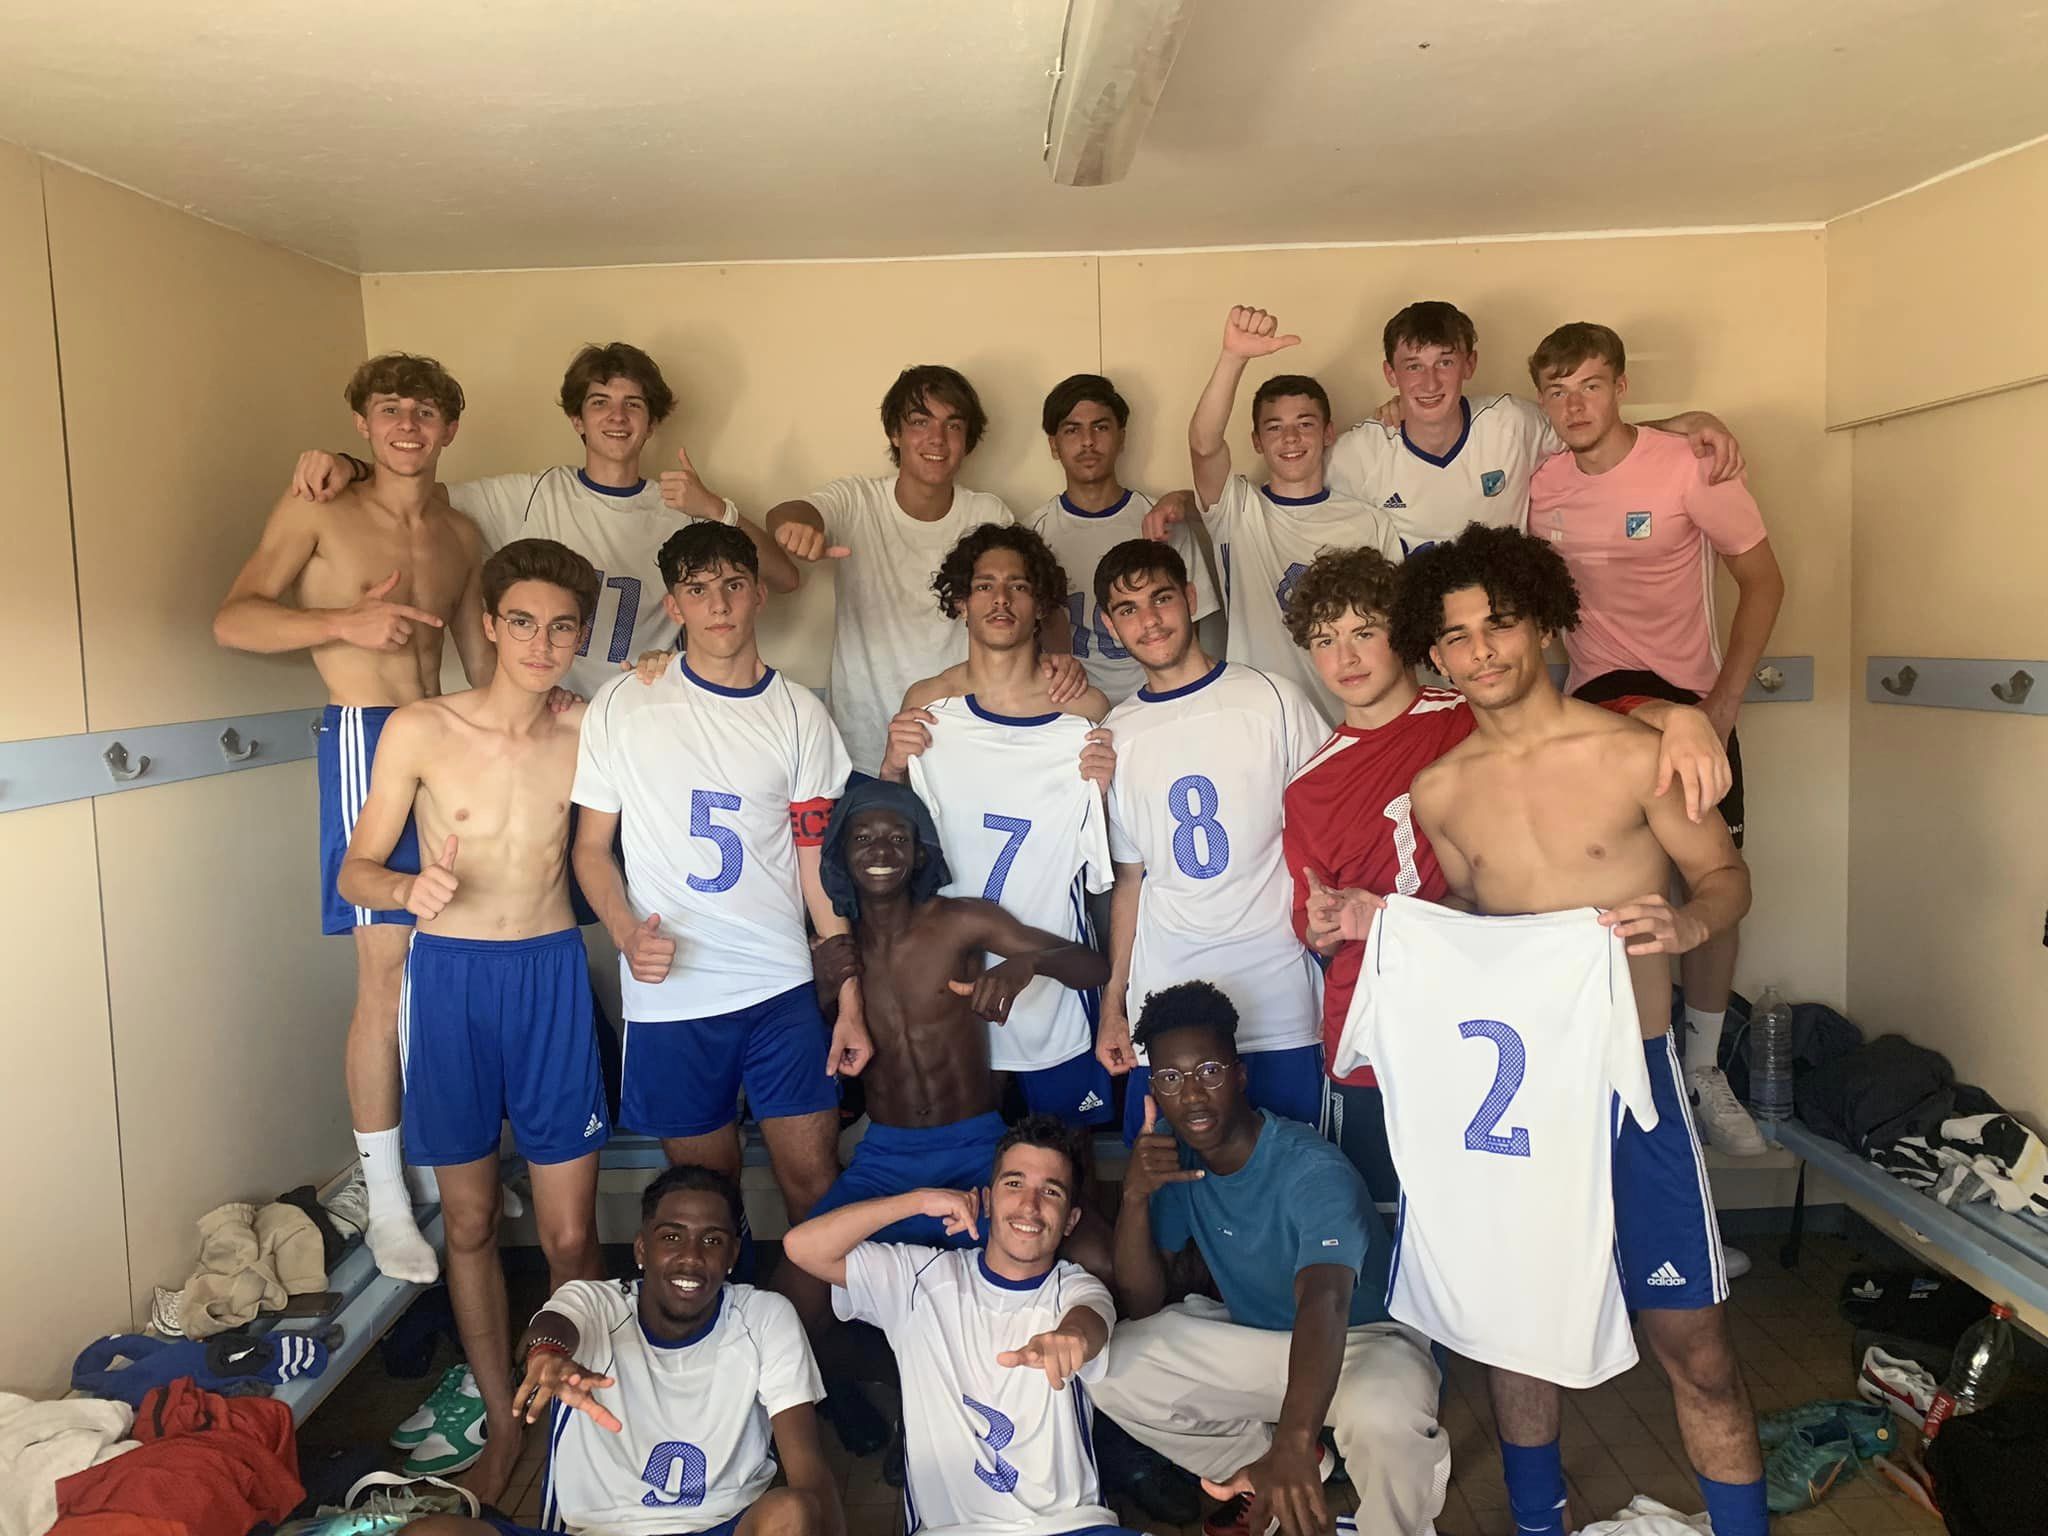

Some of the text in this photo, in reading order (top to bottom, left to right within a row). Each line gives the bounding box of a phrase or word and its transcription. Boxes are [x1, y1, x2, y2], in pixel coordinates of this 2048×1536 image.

[686, 789, 744, 893] 5
[983, 813, 1032, 905] 7
[1168, 774, 1230, 880] 8
[1458, 1019, 1531, 1157] 2
[1647, 1277, 1687, 1287] adidas
[641, 1441, 707, 1508] 9
[962, 1392, 1019, 1493] 3
